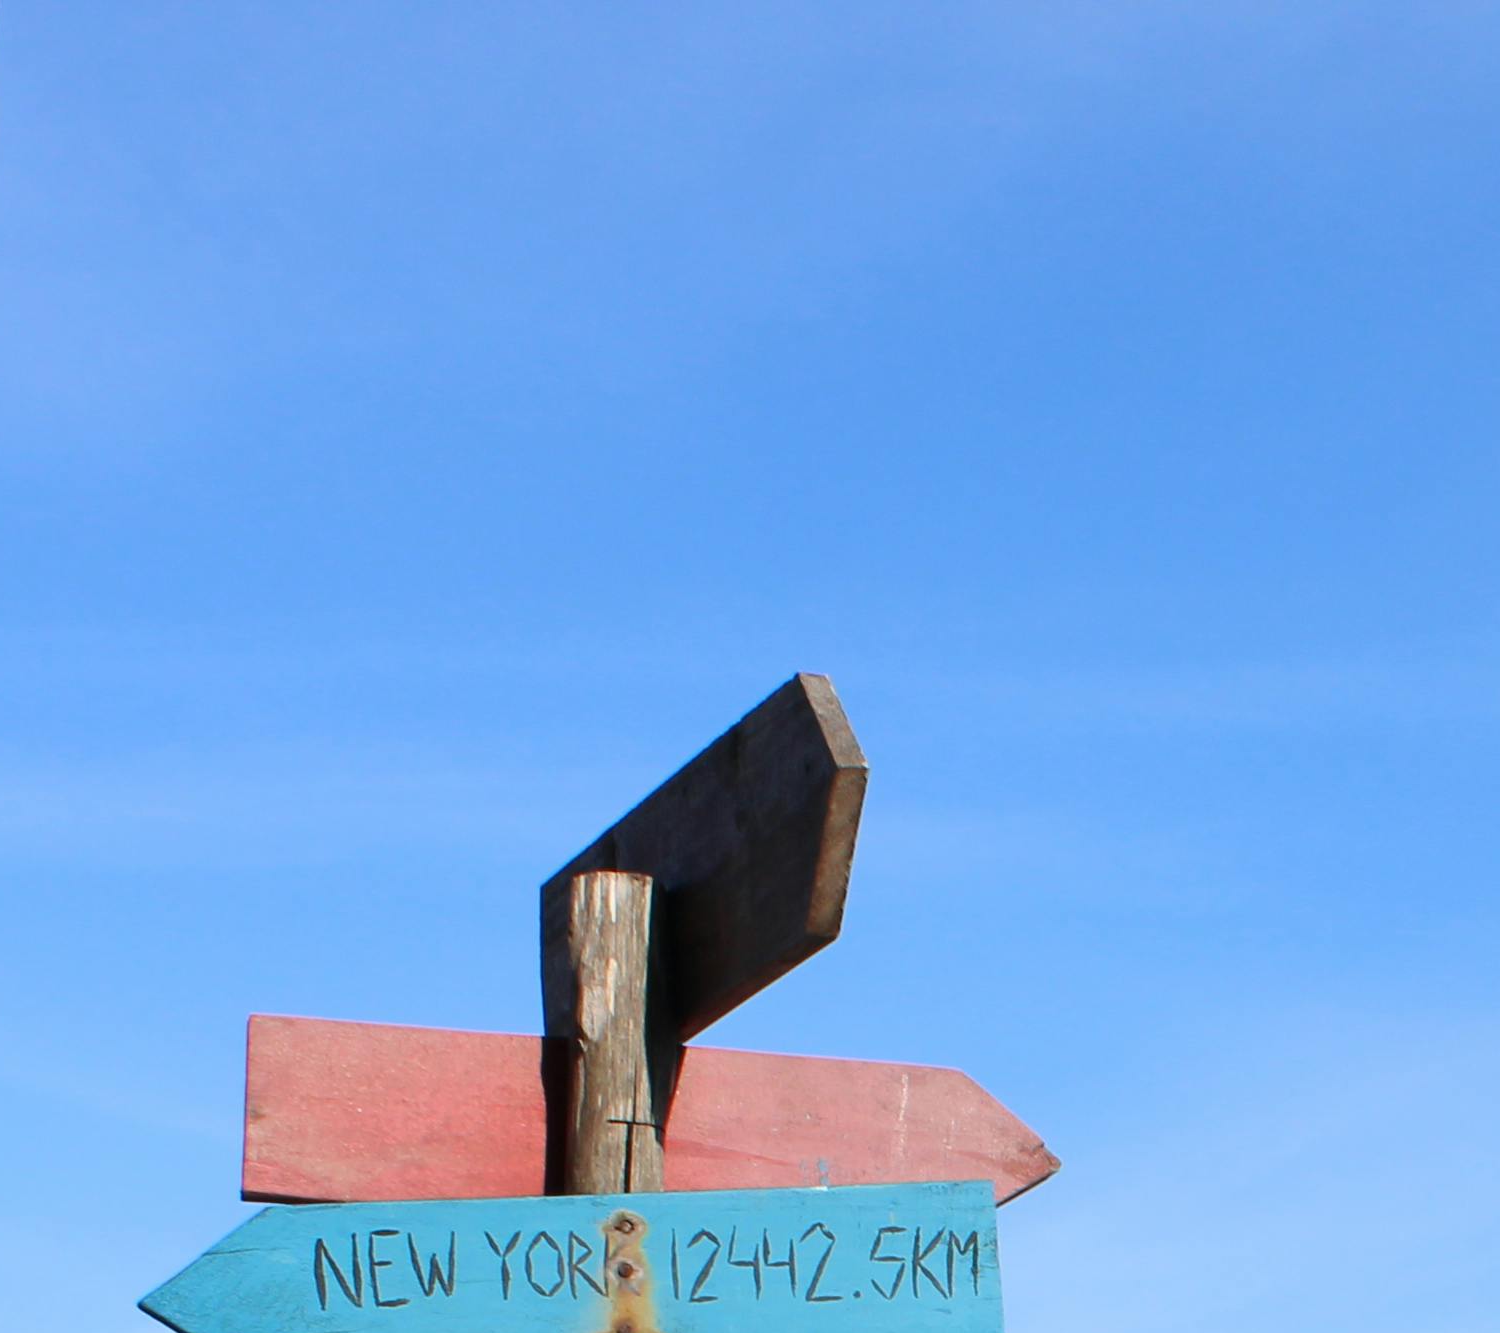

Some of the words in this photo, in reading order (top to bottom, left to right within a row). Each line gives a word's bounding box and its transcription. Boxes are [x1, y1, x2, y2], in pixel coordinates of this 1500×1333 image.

[313, 1228, 458, 1312] NEW
[484, 1229, 642, 1302] YORK
[670, 1222, 982, 1304] 12442.5KM
